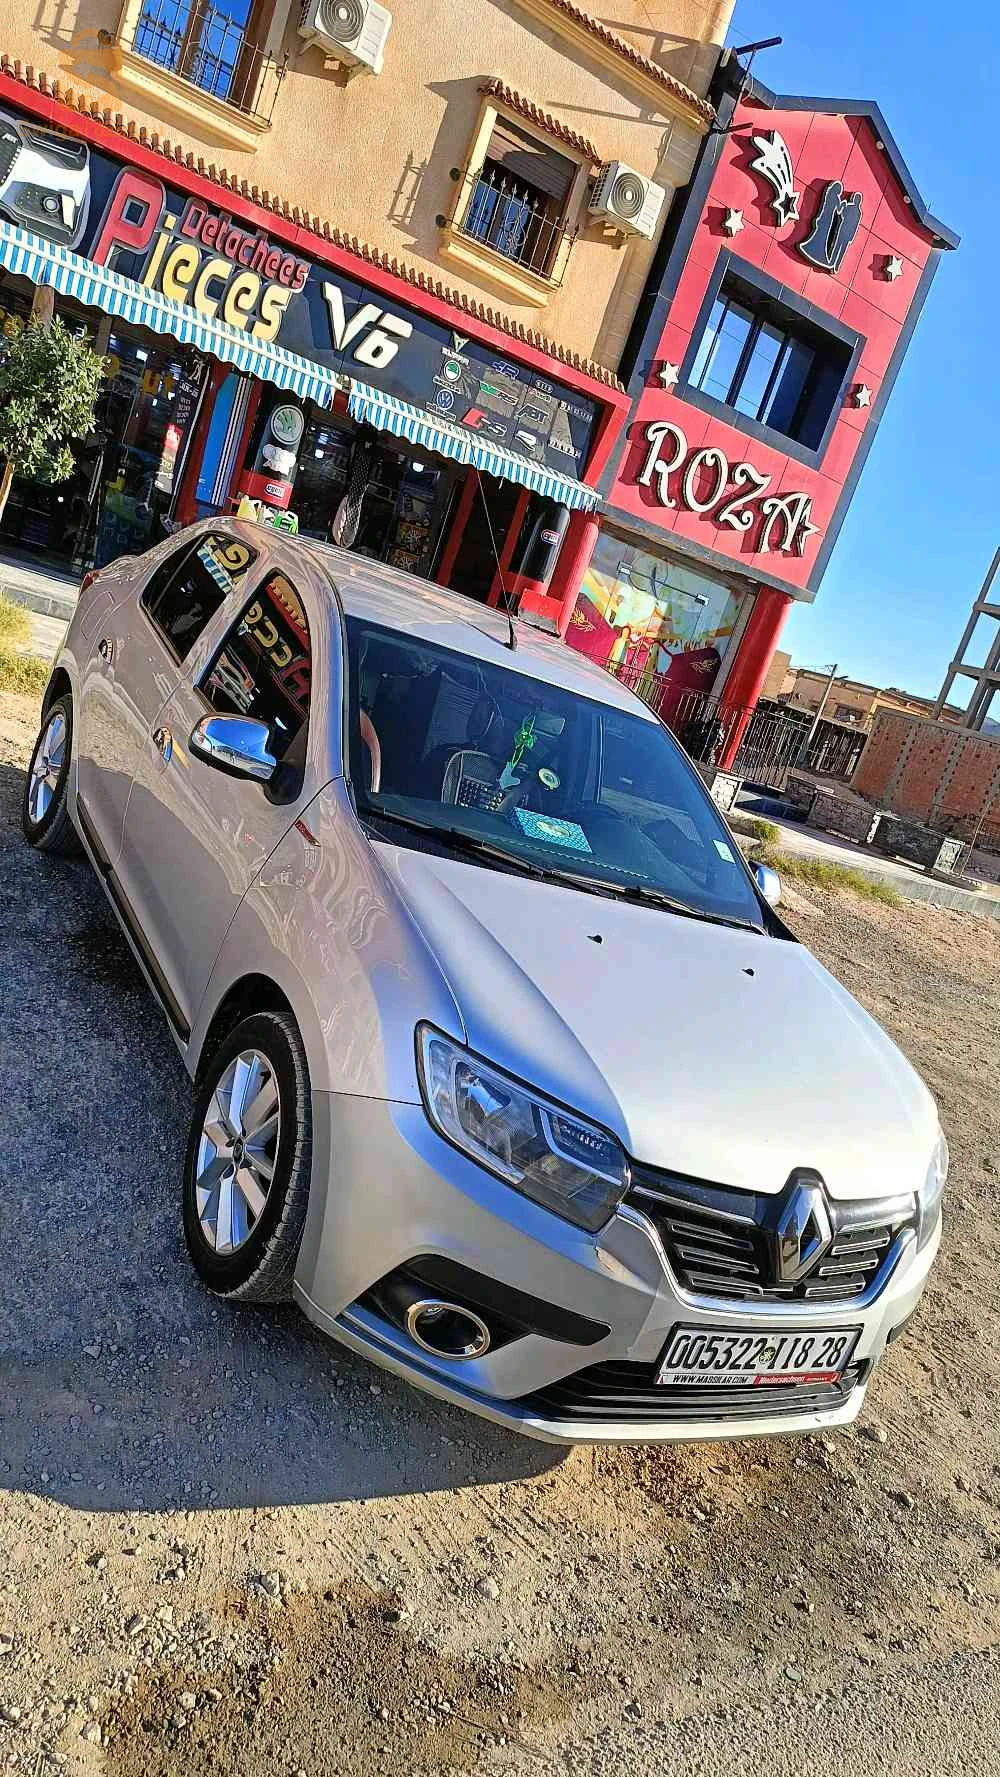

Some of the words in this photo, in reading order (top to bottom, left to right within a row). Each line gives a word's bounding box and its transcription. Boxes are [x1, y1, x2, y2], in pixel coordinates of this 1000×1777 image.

[92, 172, 291, 343] Pieces
[181, 203, 308, 289] Detachees
[322, 281, 413, 369] V6
[638, 421, 812, 554] ROZA
[666, 1335, 768, 1370] 005322
[766, 1337, 816, 1369] 118
[811, 1336, 848, 1368] 28
